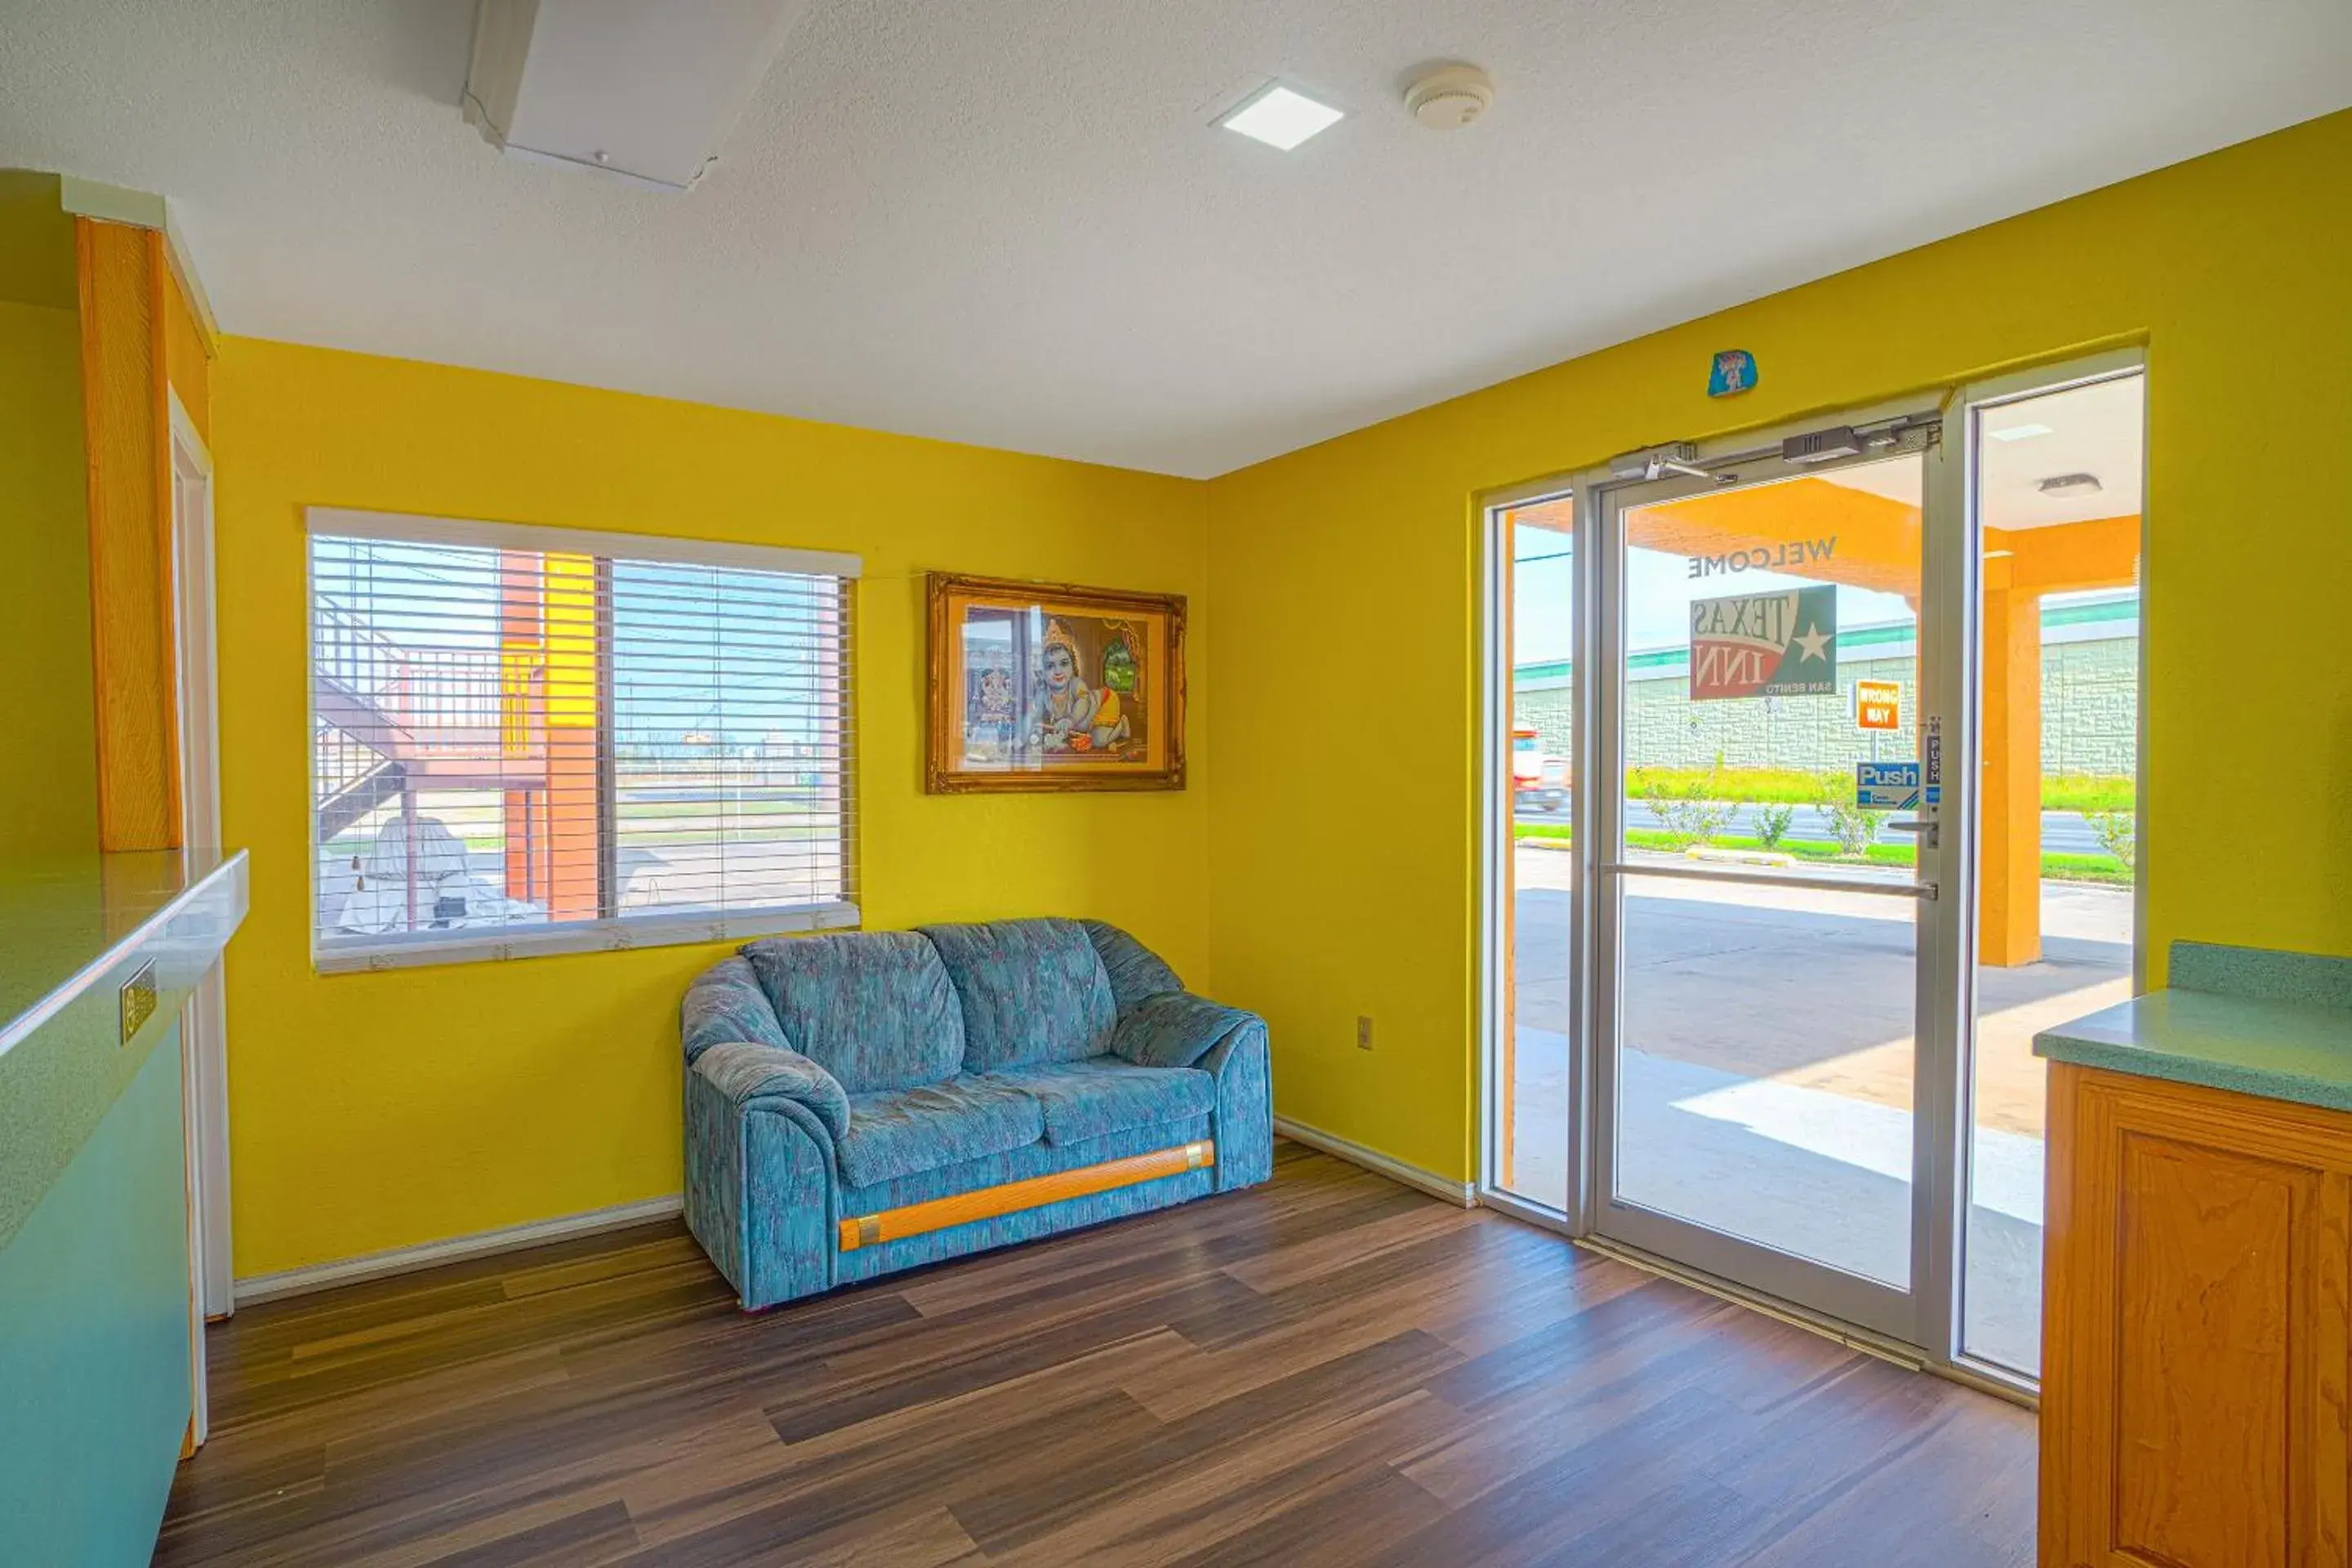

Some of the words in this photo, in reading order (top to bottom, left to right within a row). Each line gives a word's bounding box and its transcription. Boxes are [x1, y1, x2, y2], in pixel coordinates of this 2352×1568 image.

[1860, 688, 1899, 705] WRONG
[1866, 707, 1891, 724] WAY
[1931, 739, 1940, 781] PUSH
[1859, 766, 1917, 785] Push
